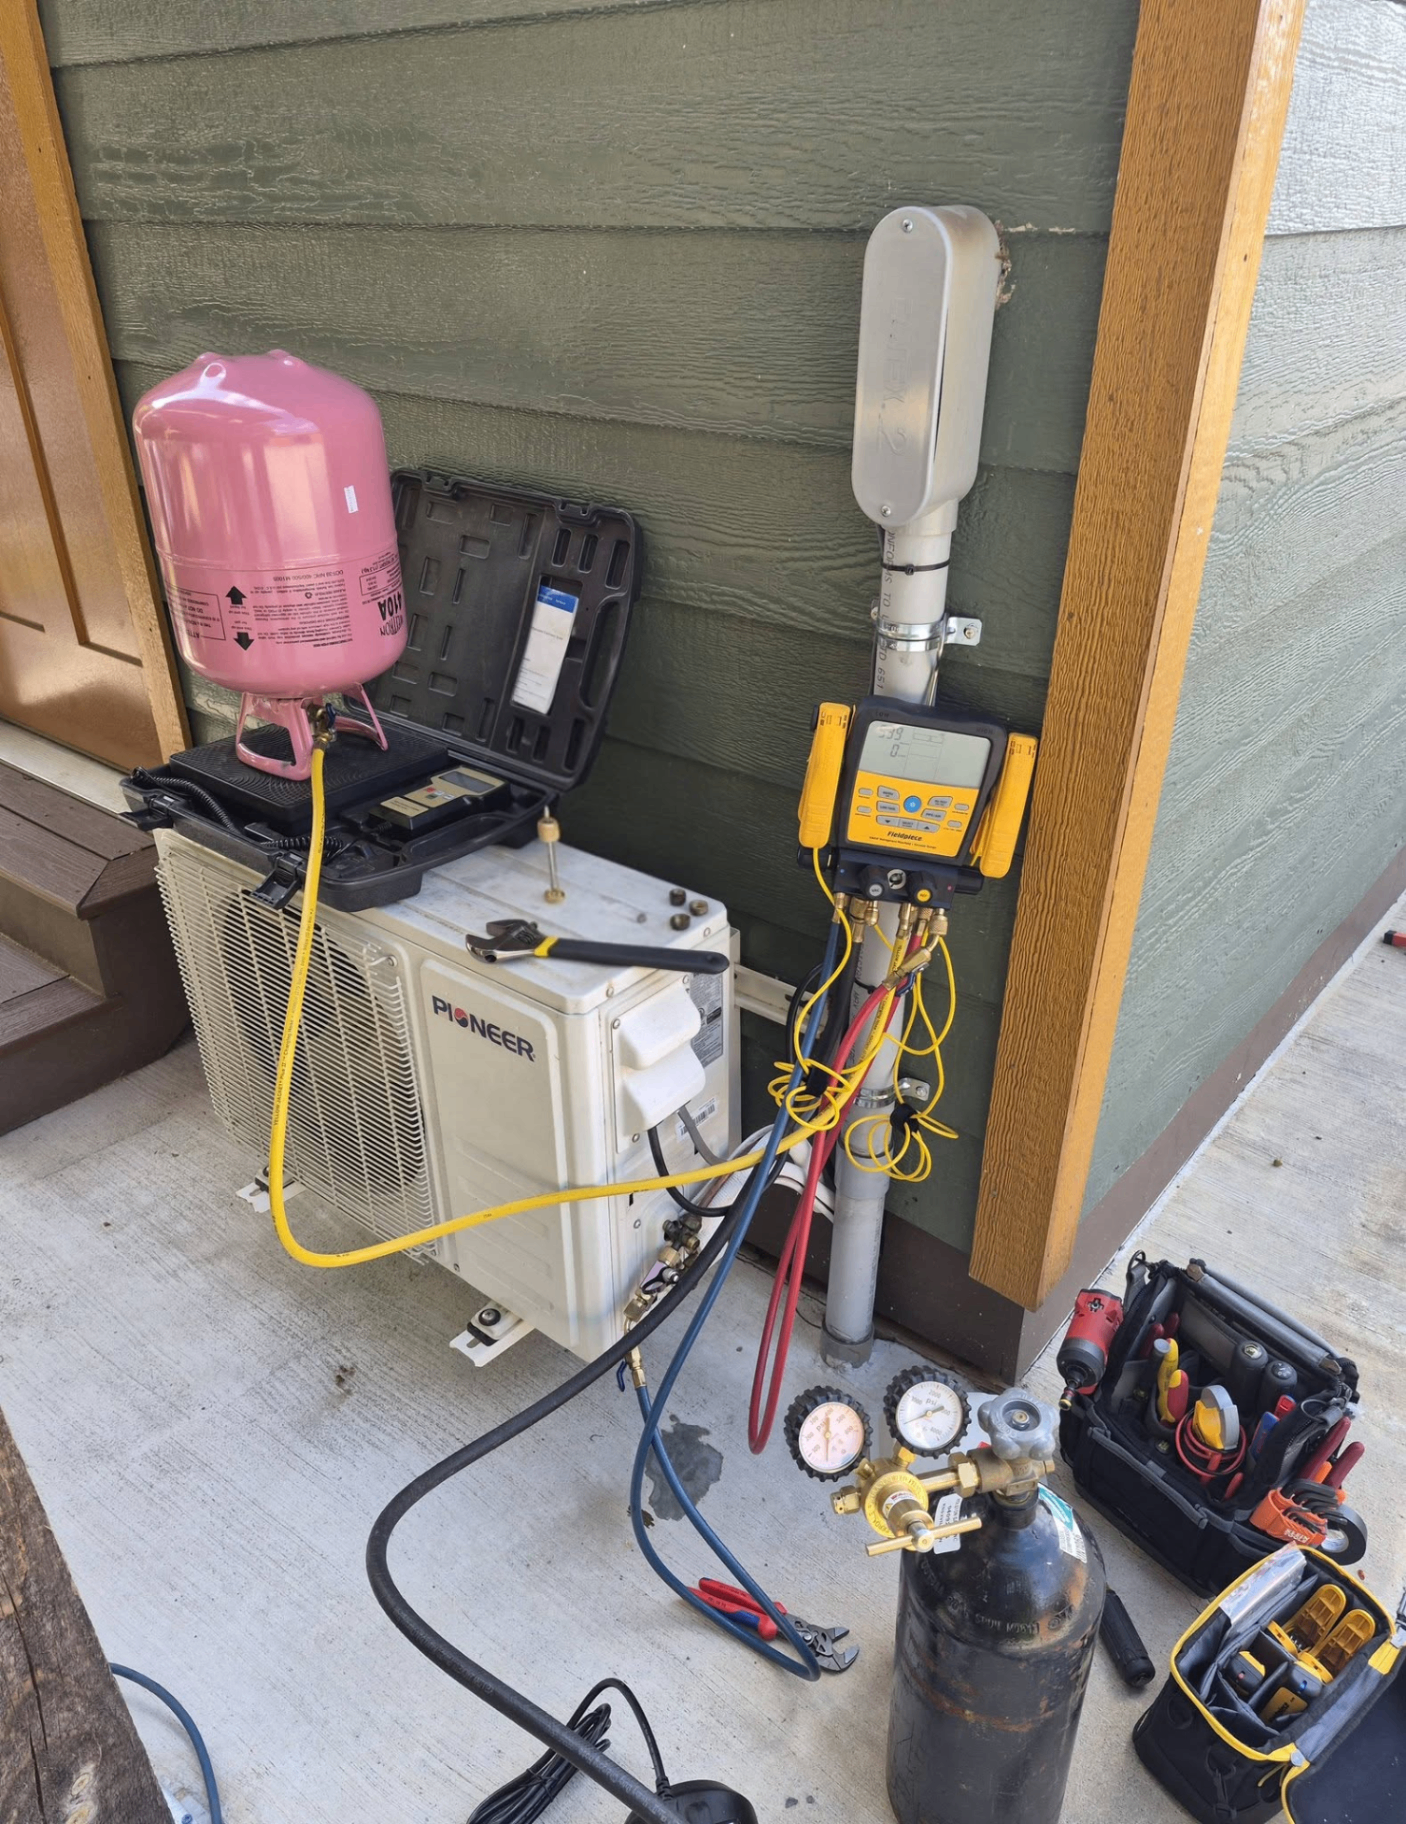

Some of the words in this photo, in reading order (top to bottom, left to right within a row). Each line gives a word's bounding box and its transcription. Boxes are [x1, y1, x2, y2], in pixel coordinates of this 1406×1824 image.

[883, 592, 892, 607] TO
[876, 667, 886, 690] 651
[887, 831, 923, 842] Fieldpiece
[431, 995, 535, 1062] PIONEER
[282, 1032, 291, 1055] Charging
[926, 1398, 938, 1406] psi
